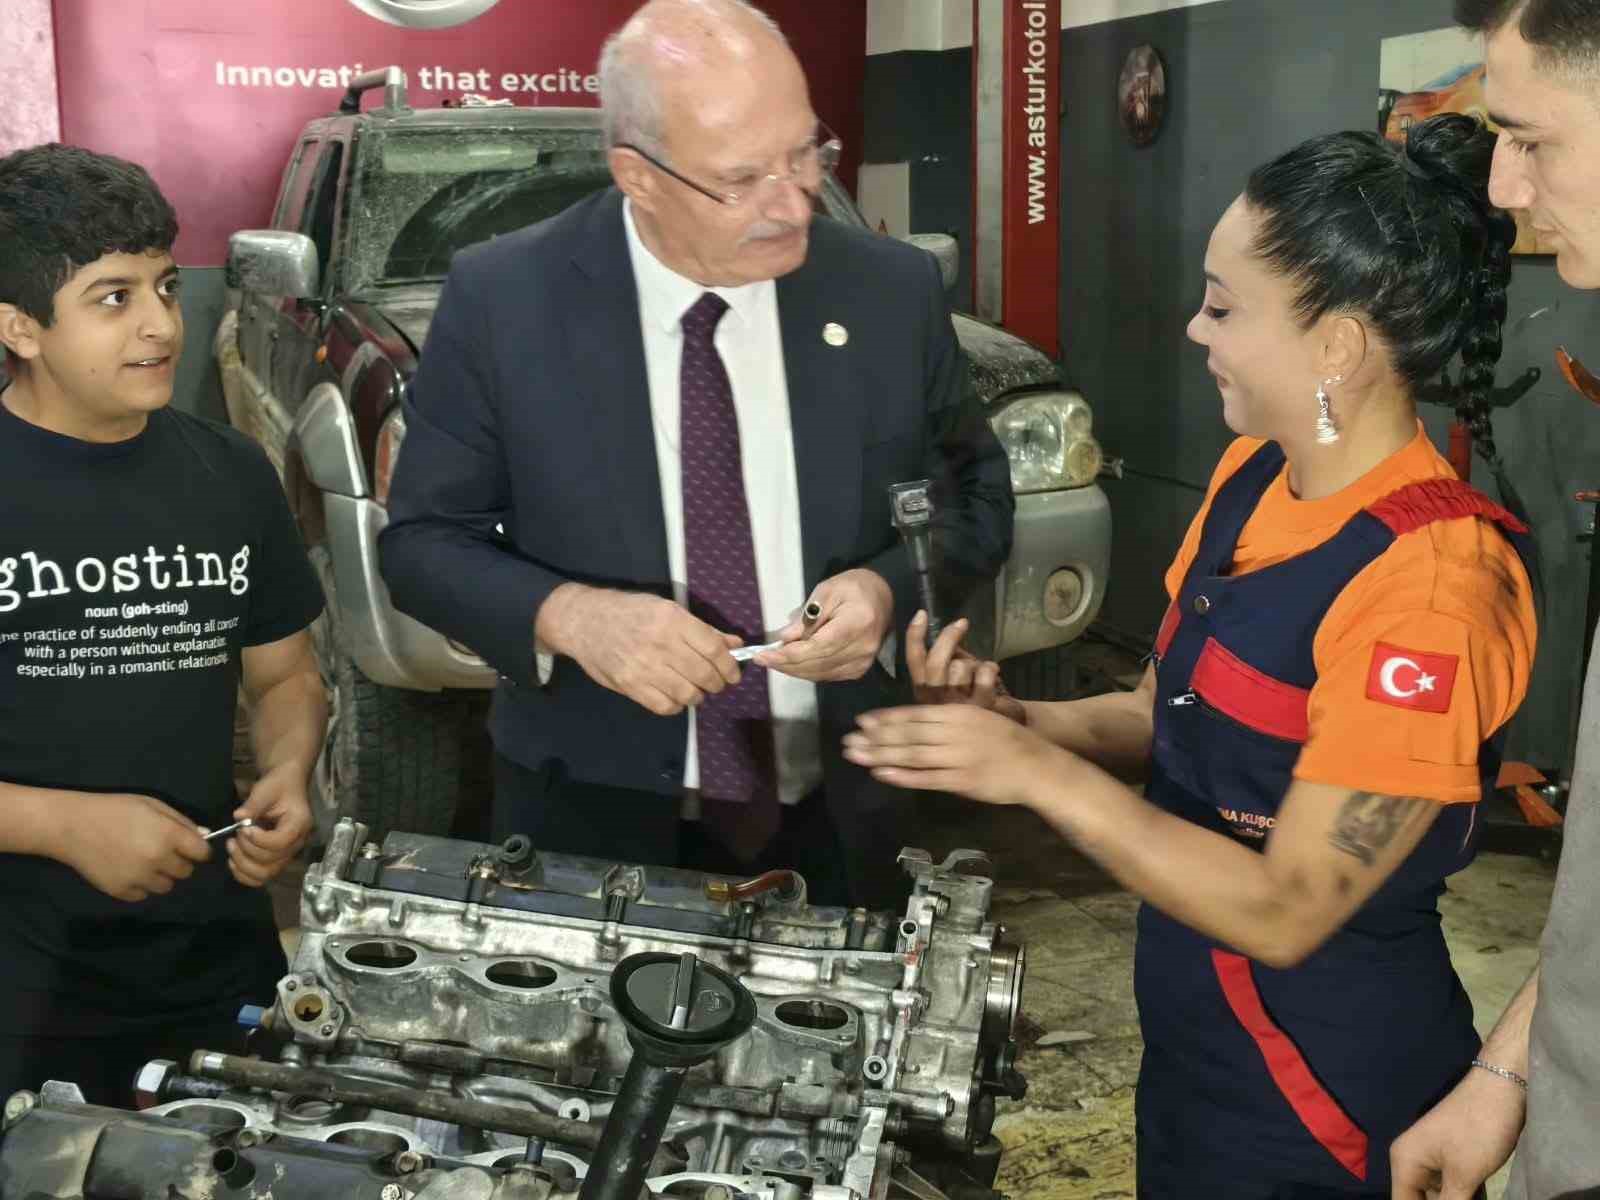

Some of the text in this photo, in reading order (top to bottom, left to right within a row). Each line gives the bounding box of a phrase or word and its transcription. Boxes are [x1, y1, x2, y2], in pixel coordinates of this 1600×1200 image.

[215, 61, 600, 93] Innovati that excite
[0, 544, 250, 612] ghosting
[85, 599, 189, 619] noun (goh-sting)
[24, 627, 77, 642] practice
[80, 625, 96, 640] of
[99, 623, 158, 640] suddenly
[162, 620, 201, 636] ending
[204, 618, 216, 633] all
[24, 644, 54, 658] with
[57, 647, 67, 659] a
[70, 645, 117, 661] person
[120, 640, 171, 656] without
[16, 662, 85, 679] especially
[90, 661, 104, 676] in
[107, 664, 117, 676] a
[120, 658, 176, 674] romantic
